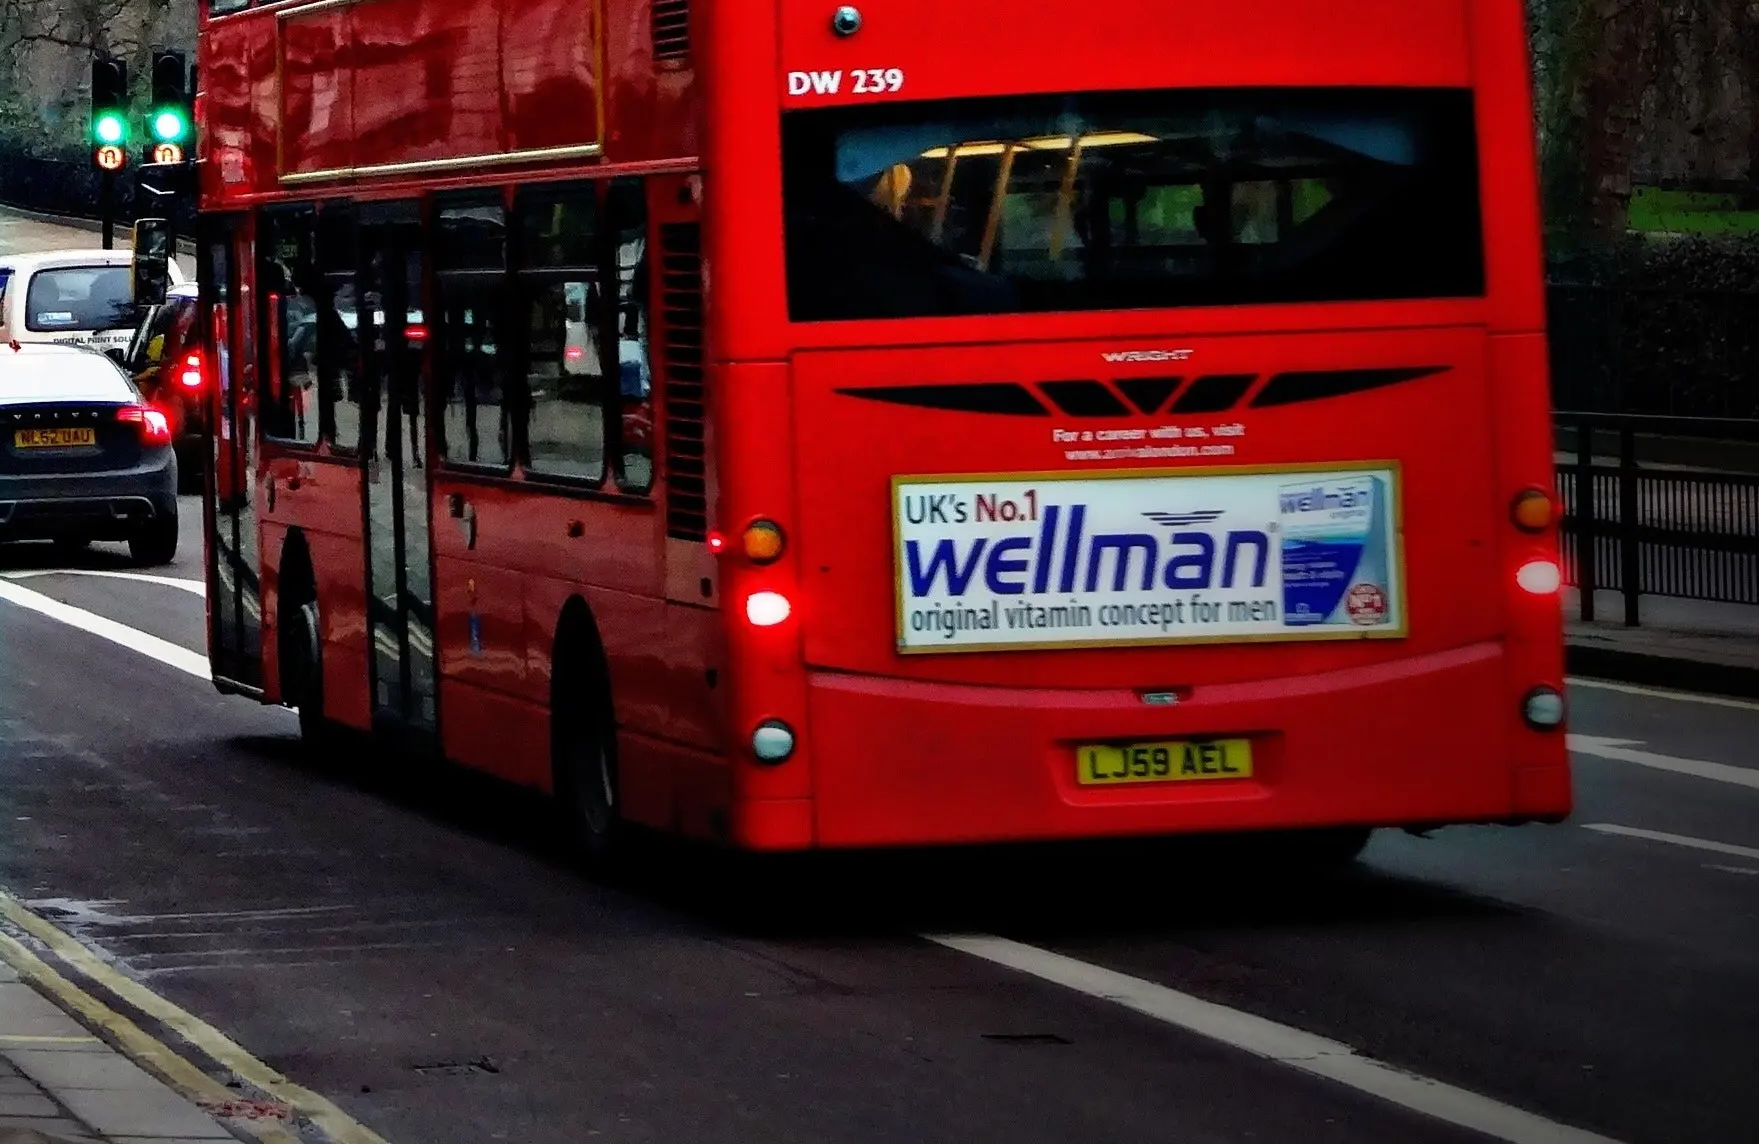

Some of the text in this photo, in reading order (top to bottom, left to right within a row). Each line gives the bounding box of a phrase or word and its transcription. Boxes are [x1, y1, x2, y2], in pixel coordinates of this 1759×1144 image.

[788, 67, 903, 96] DW 239
[87, 336, 111, 344] PRINT
[1100, 349, 1194, 362] WRIGHT
[13, 412, 99, 420] VOLVO
[1052, 423, 1245, 442] For a career with us, visit
[904, 490, 1039, 524] UK's No.1
[903, 504, 1270, 597] wellman
[911, 600, 999, 638] original
[1004, 599, 1091, 630] vitamin
[1099, 599, 1183, 632] concept
[1190, 595, 1222, 623] for
[1227, 600, 1277, 623] men
[1090, 744, 1238, 779] LJ59 AEL
